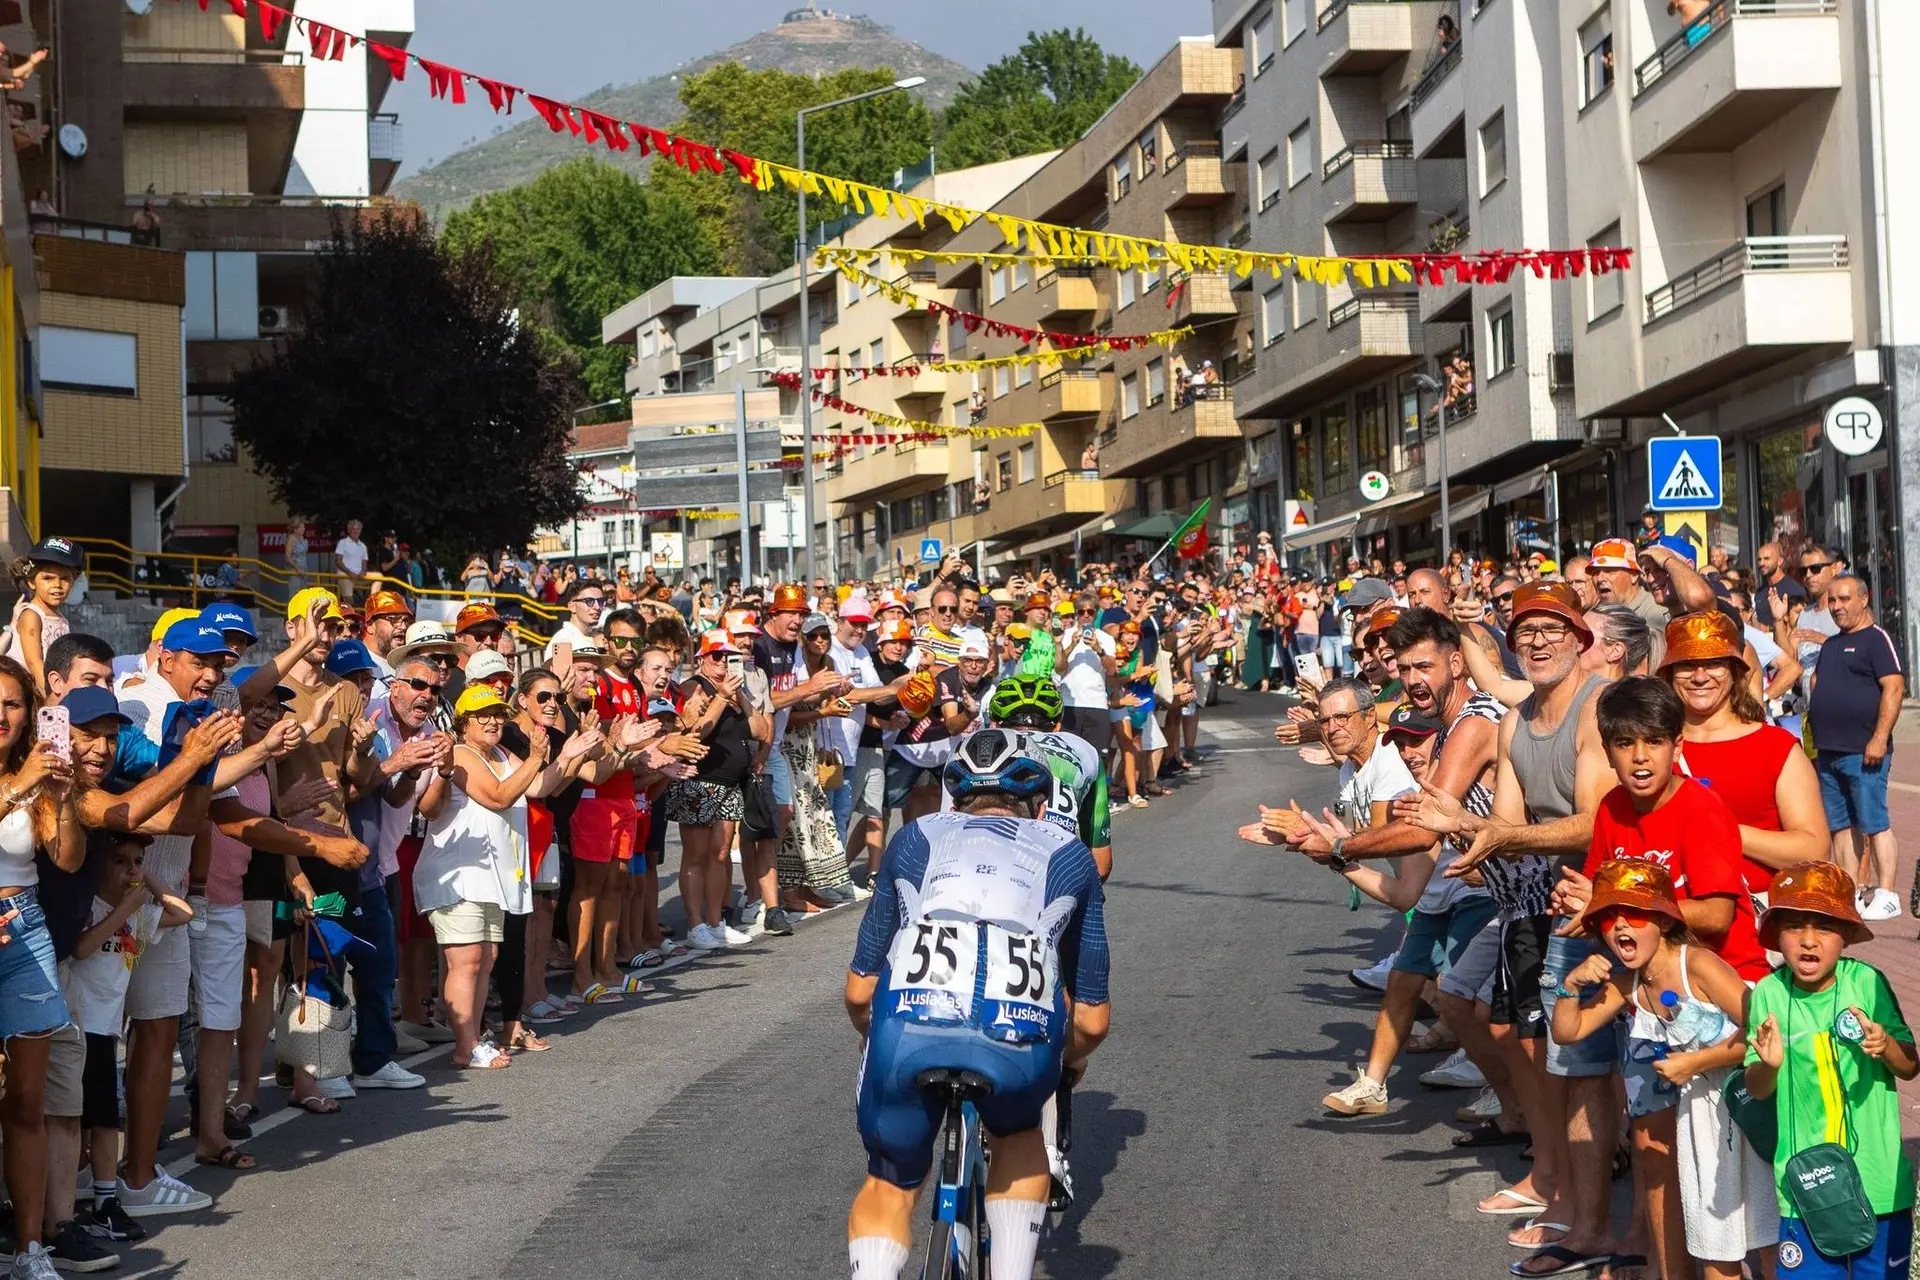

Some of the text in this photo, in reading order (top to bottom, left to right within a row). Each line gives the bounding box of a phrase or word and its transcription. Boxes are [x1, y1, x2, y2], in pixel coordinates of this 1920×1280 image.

[1043, 812, 1075, 832] usíadas
[906, 924, 958, 985] 55
[1005, 935, 1046, 1001] 55
[1005, 1002, 1049, 1026] Lusíadas
